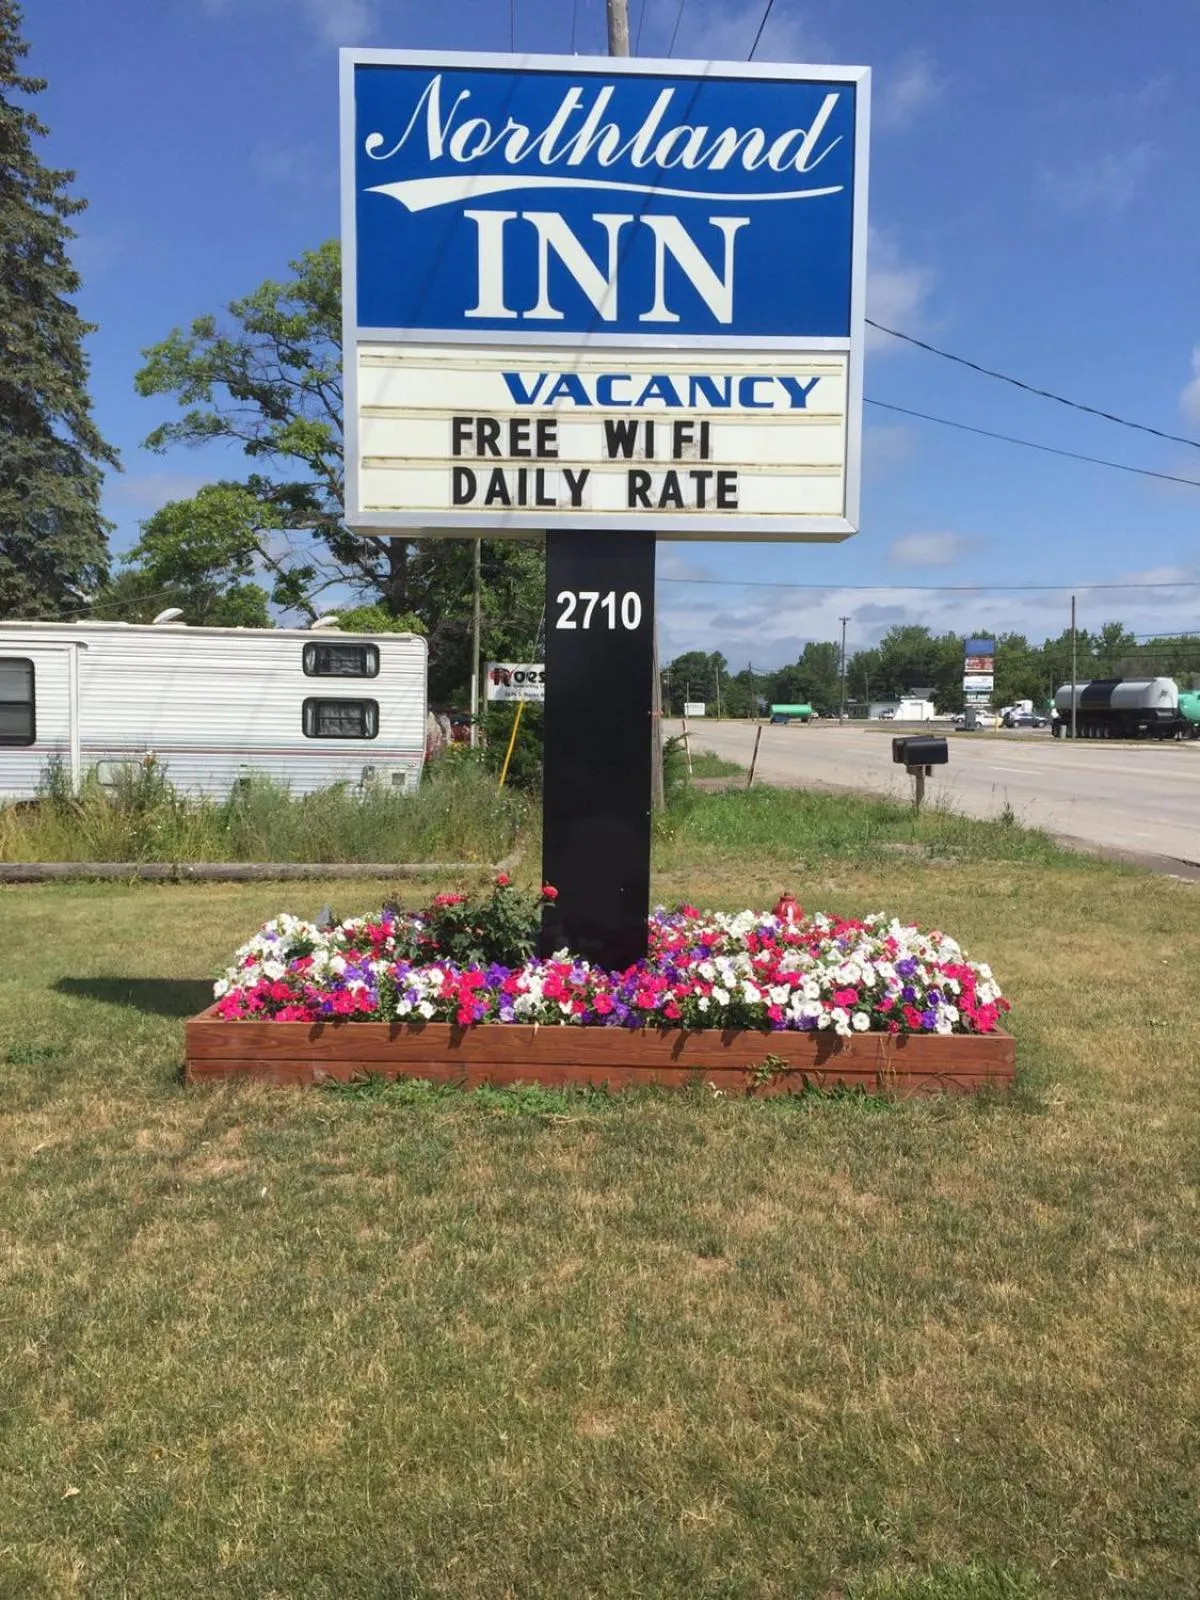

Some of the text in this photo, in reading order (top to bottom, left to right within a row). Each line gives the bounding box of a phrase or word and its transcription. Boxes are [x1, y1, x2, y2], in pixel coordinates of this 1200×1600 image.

[365, 74, 844, 172] Northland
[463, 209, 750, 324] INN
[501, 372, 821, 409] VACANCY
[452, 417, 711, 460] FREE WIFI
[452, 467, 738, 510] DAILY RATE
[555, 590, 642, 630] 2710
